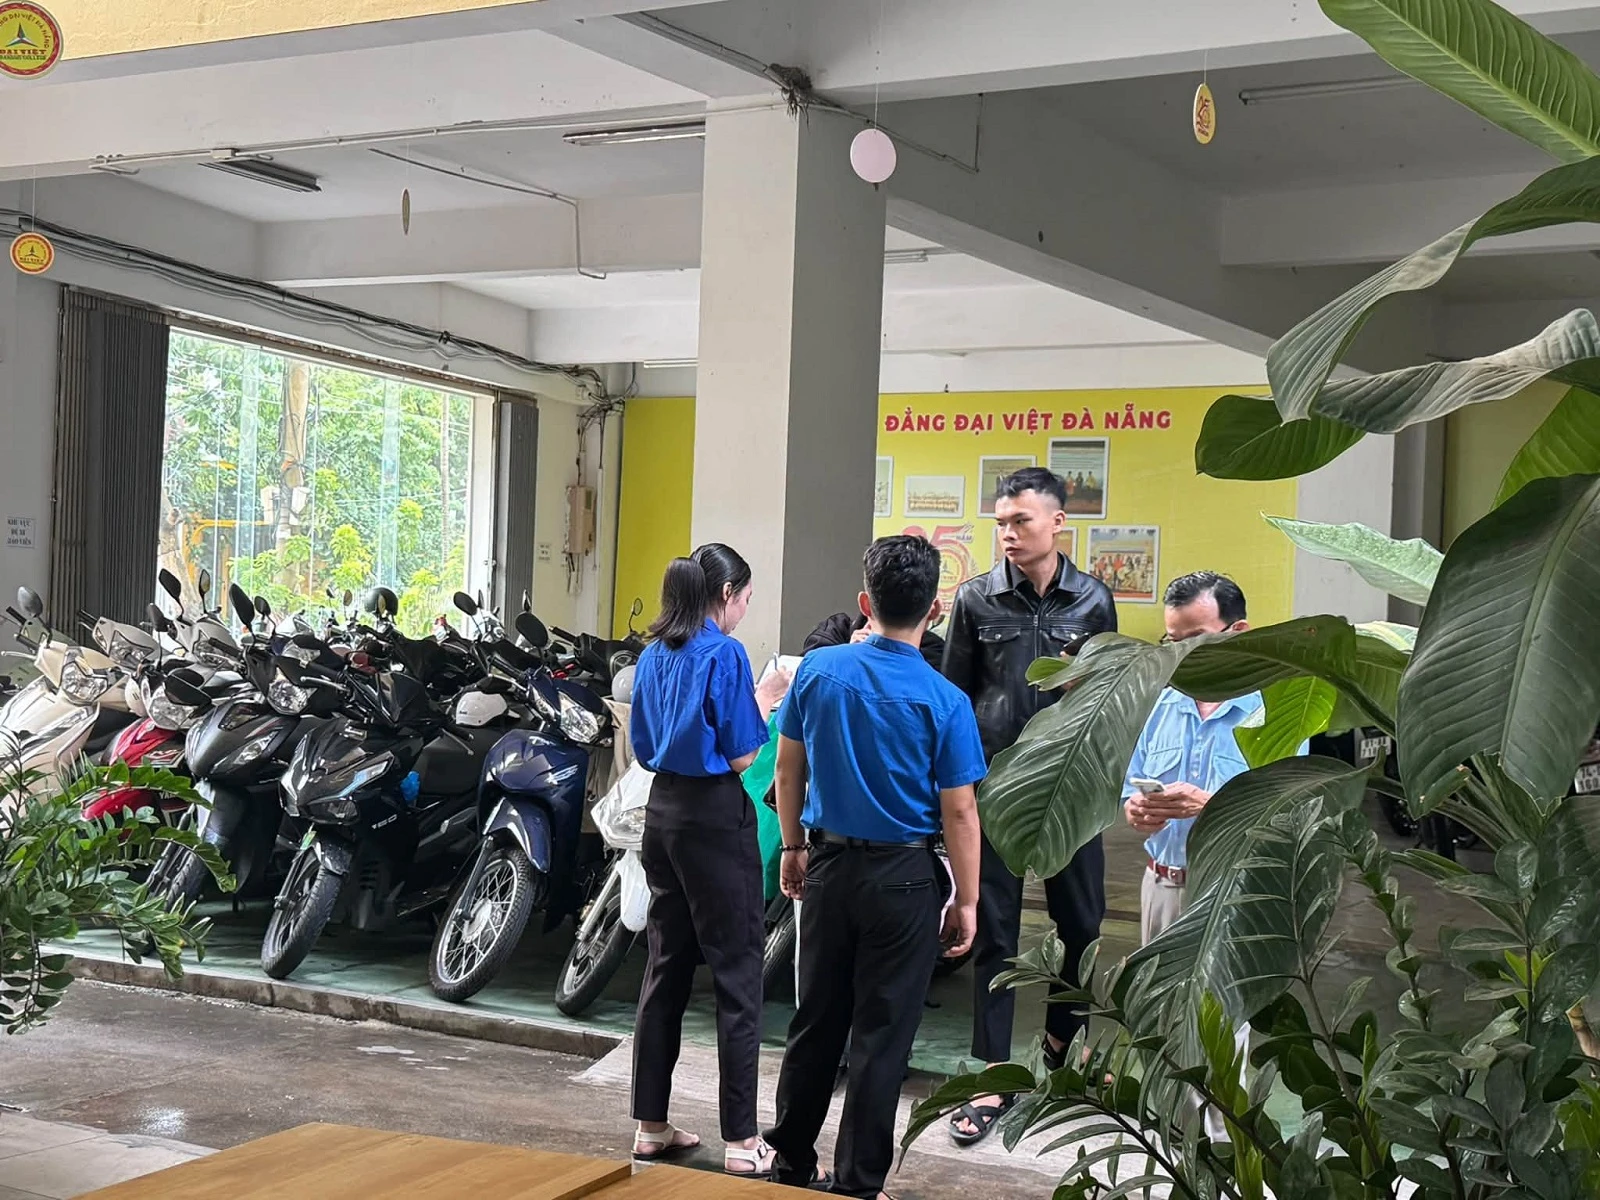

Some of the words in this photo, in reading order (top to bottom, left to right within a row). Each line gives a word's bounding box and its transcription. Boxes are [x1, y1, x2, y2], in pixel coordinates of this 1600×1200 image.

[884, 406, 945, 432] ĐẲNG
[953, 413, 994, 436] ĐẠI
[1001, 408, 1053, 435] VIỆT
[1061, 407, 1094, 430] ĐÀ
[1104, 402, 1171, 430] NẴNG
